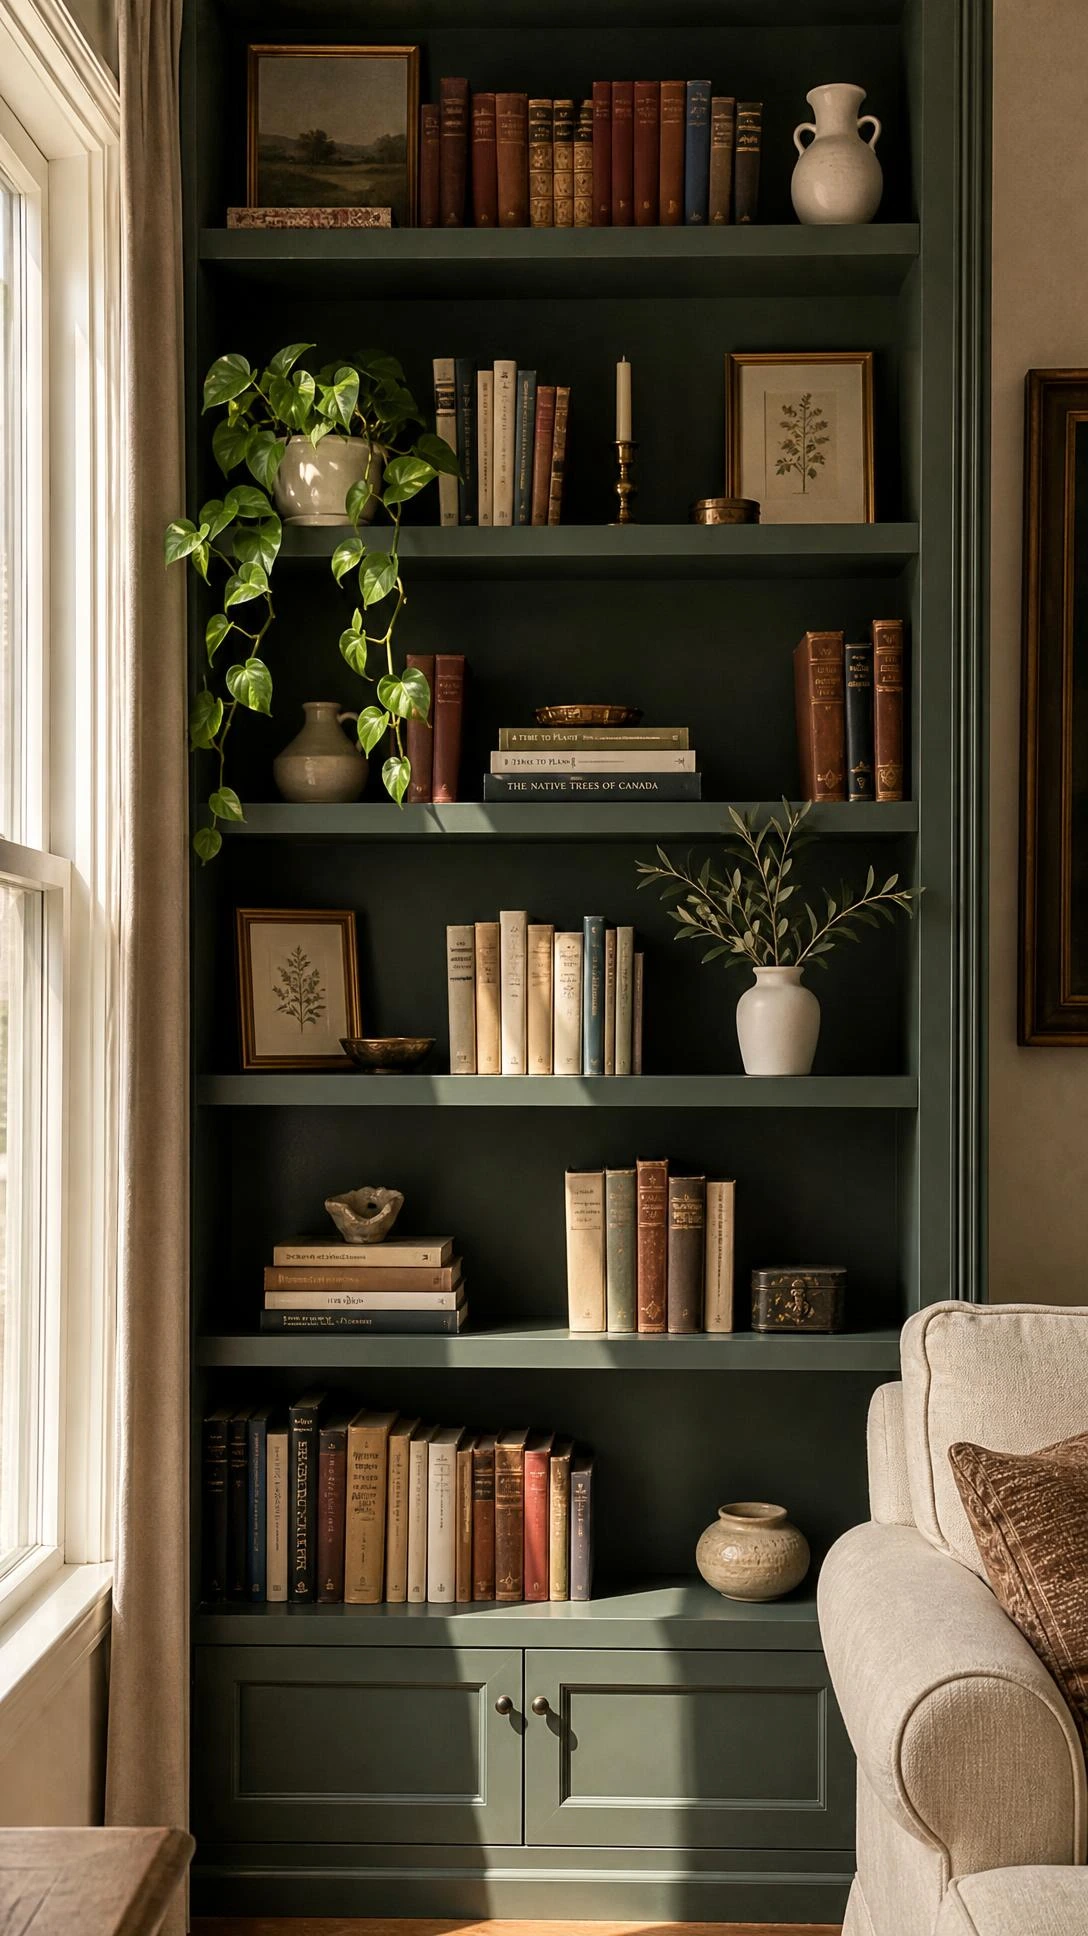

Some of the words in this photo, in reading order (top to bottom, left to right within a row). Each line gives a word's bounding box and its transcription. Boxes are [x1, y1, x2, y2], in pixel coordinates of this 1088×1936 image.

[507, 782, 527, 790] THE
[530, 782, 567, 790] NATIVE
[569, 782, 600, 790] TREES
[602, 782, 616, 790] OF
[618, 782, 659, 790] CANADA
